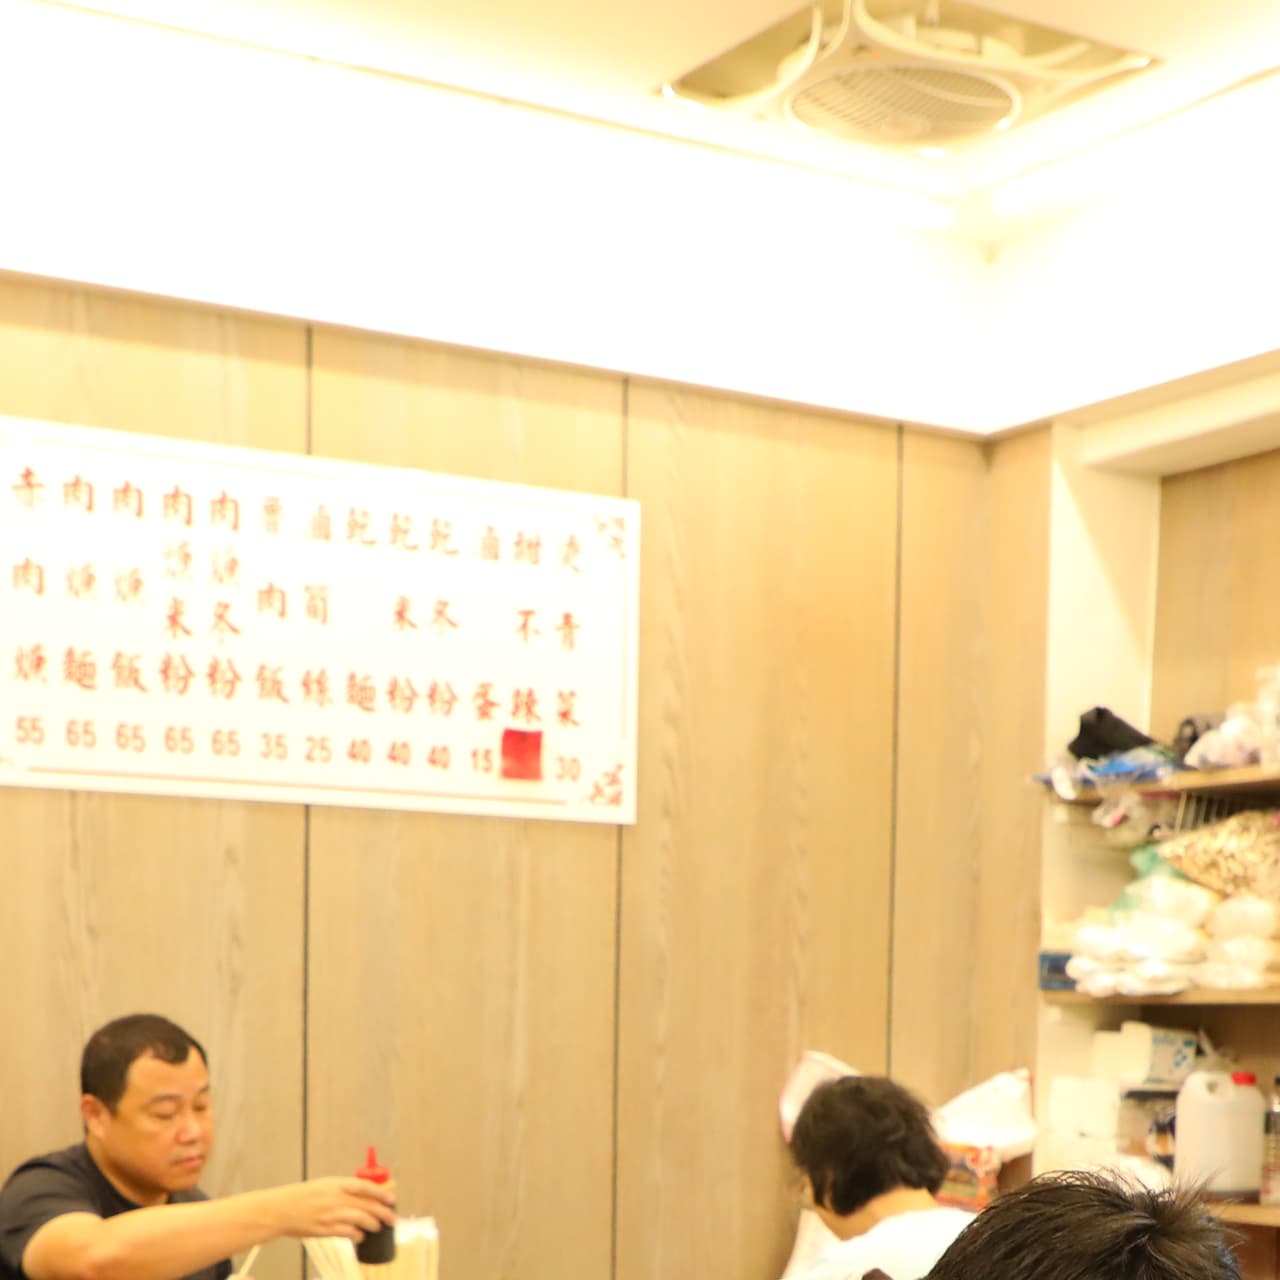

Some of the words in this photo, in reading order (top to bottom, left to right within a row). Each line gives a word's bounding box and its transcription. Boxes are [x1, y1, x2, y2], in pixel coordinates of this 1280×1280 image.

[509, 531, 544, 726] 甜不辣
[14, 715, 47, 747] 55
[64, 718, 98, 750] 65
[114, 721, 148, 755] 65
[162, 724, 196, 756] 65
[210, 728, 242, 758] 65
[259, 731, 288, 763] 35
[304, 735, 333, 765] 25
[345, 737, 373, 766] 40
[384, 739, 413, 768] 40
[425, 744, 452, 772] 40
[471, 745, 495, 777] 15
[553, 752, 582, 784] 30
